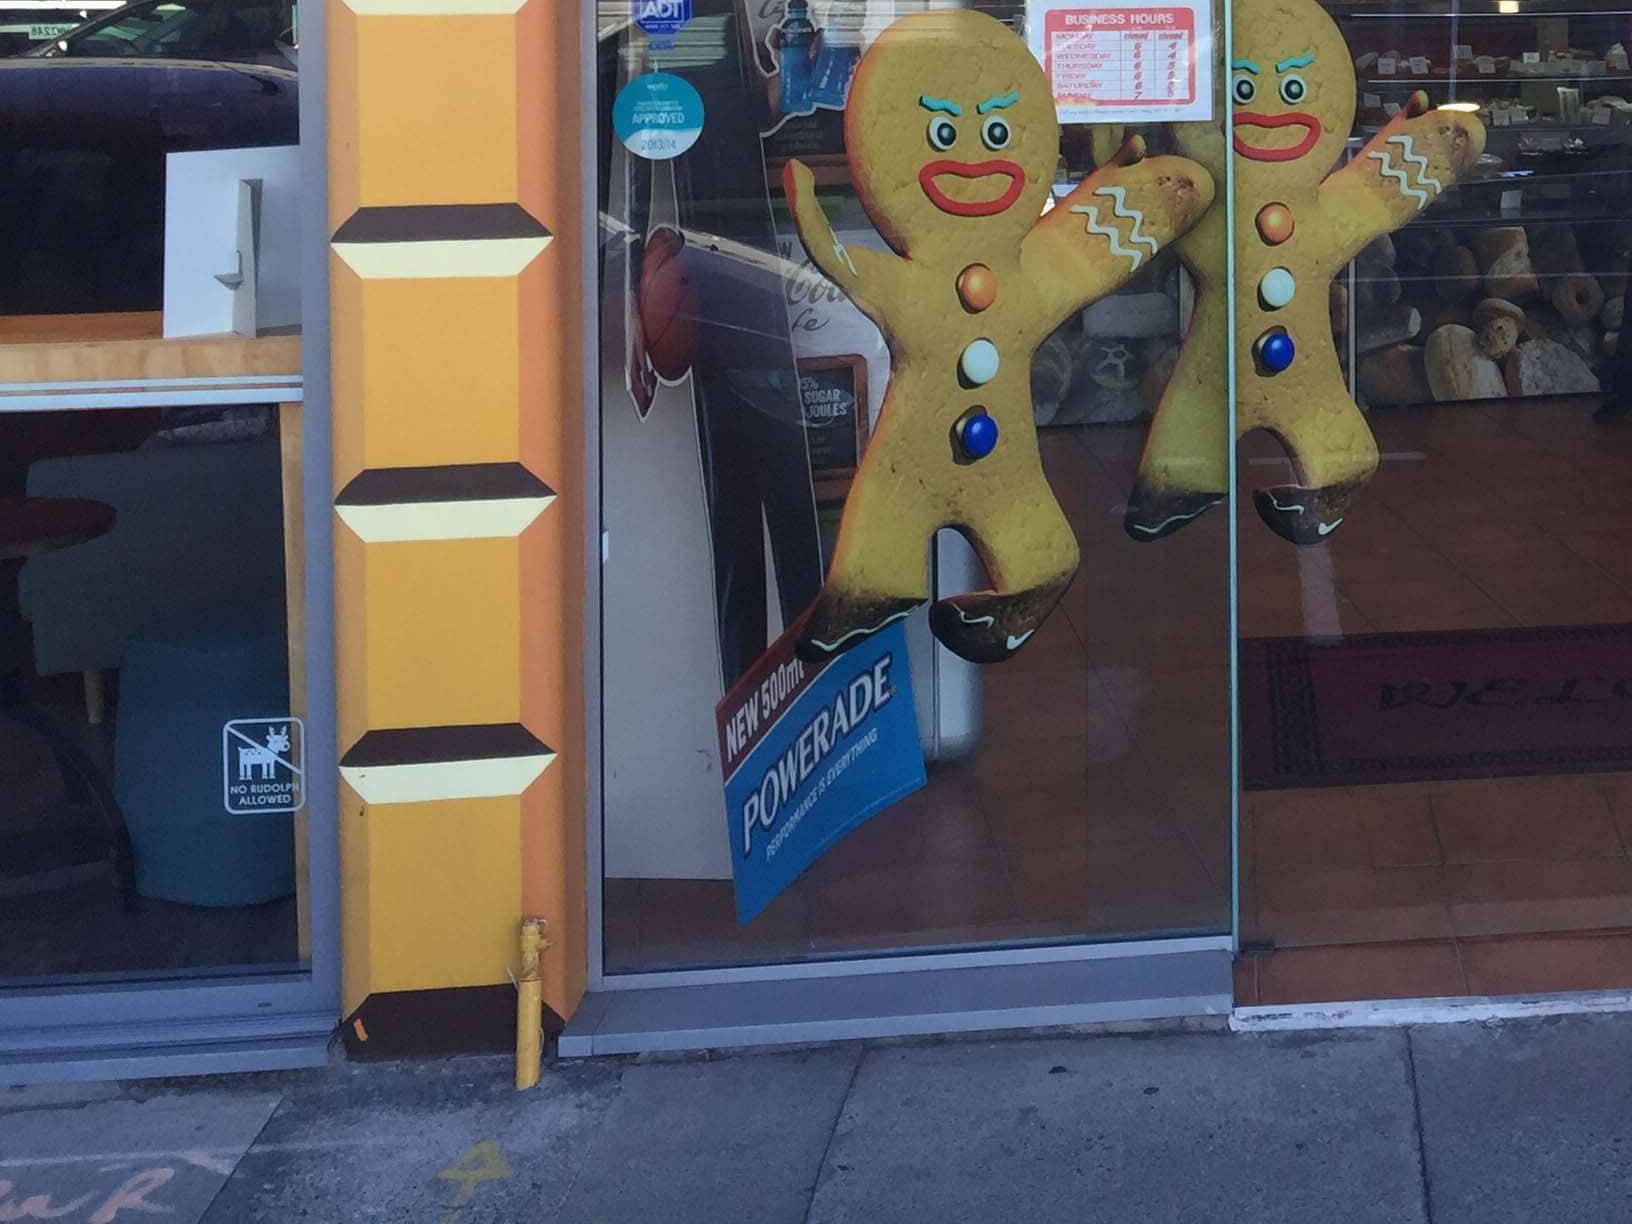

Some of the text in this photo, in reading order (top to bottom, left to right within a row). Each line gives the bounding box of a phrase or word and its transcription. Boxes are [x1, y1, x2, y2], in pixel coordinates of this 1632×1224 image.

[1065, 13, 1174, 25] BUSINESS HOURS
[631, 111, 686, 124] APPROVED
[804, 389, 841, 405] SUGAR
[725, 696, 760, 763] NEW
[743, 654, 892, 856] POWERADE
[230, 783, 300, 794] NO RUDOLPH
[239, 794, 292, 806] ALLOWED
